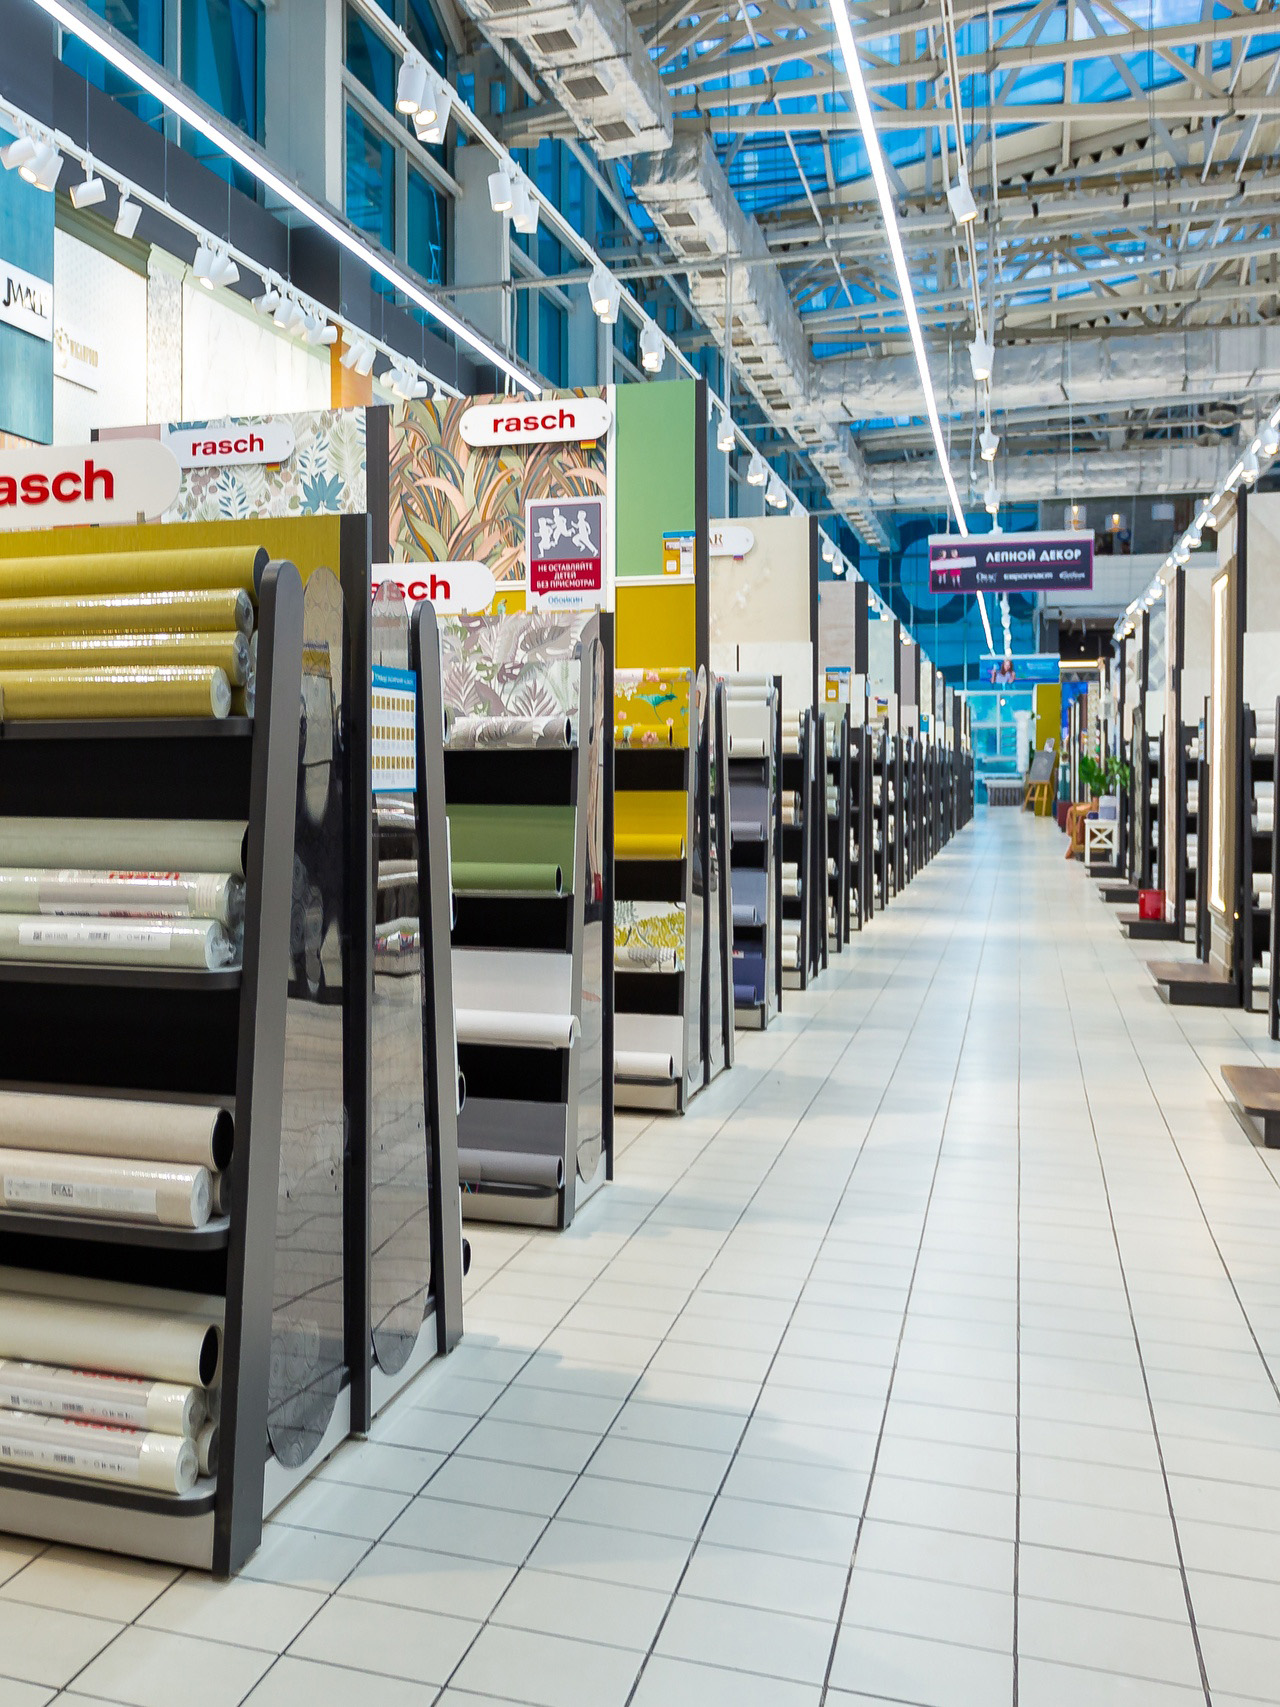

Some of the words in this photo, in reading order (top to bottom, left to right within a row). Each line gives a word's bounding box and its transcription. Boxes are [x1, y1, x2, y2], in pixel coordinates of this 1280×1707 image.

[493, 408, 575, 433] rasch
[191, 433, 264, 457] rasch
[985, 548, 1036, 563] ЛЕПНОЙ
[1039, 548, 1082, 562] ДЕКОР
[538, 564, 547, 572] НЕ
[548, 562, 593, 572] ОСТАВЛЯЙТЕ
[554, 571, 577, 580] ДЕТЕЙ
[536, 580, 549, 589] БЕЗ
[550, 579, 595, 588] ПРИСМОТРА!
